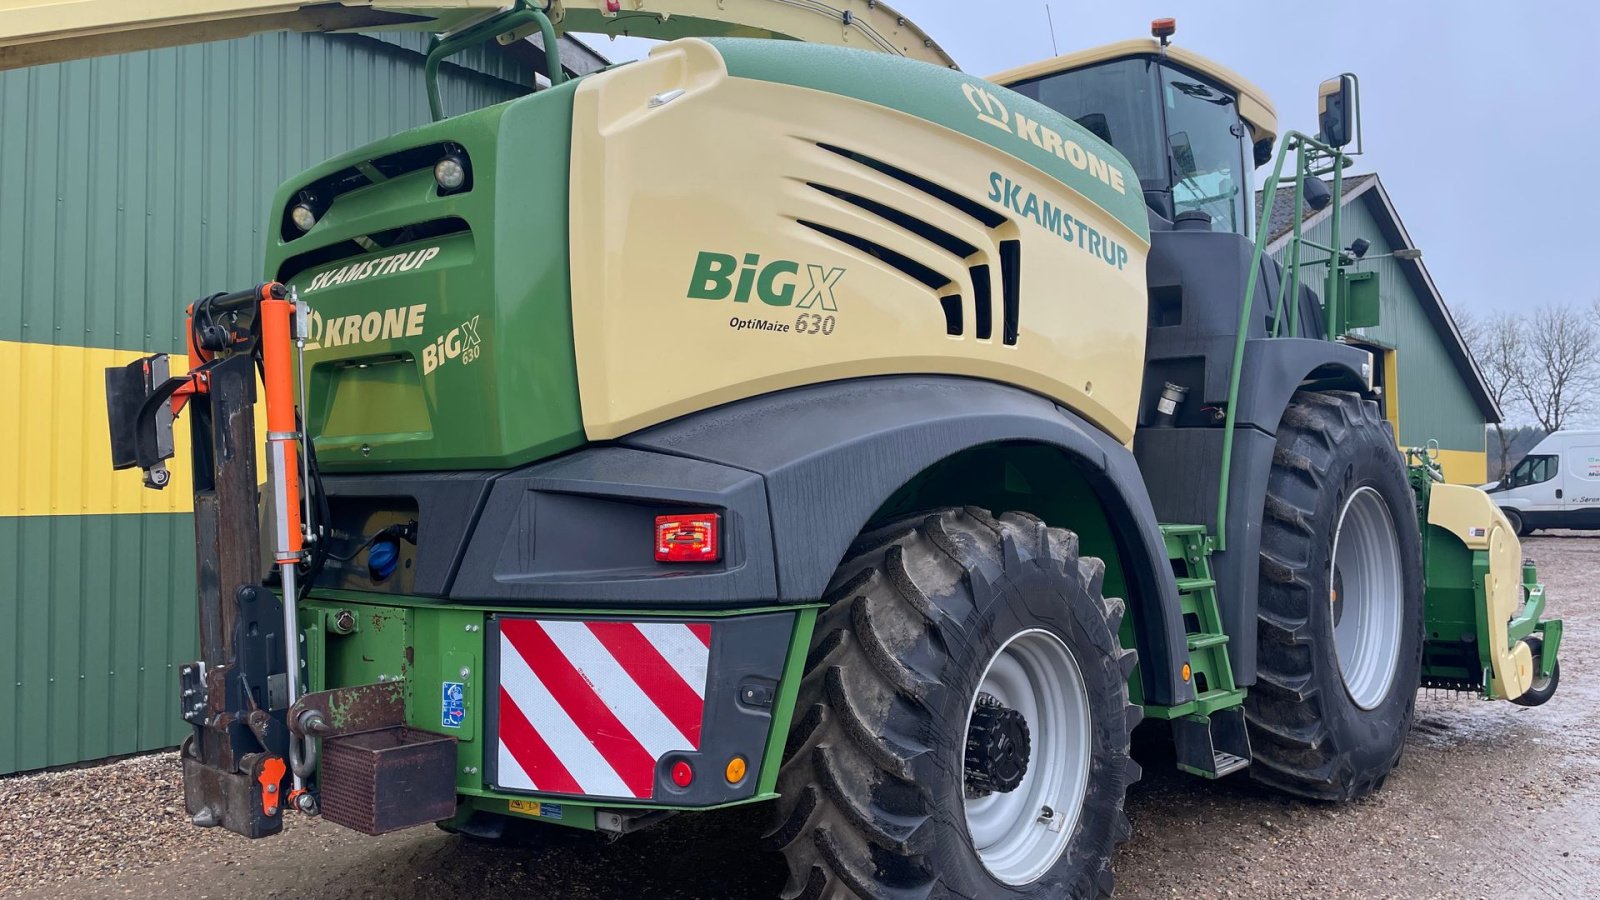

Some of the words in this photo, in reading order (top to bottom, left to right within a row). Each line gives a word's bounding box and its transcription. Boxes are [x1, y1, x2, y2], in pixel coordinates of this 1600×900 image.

[1015, 112, 1125, 195] KRONE
[988, 171, 1128, 270] SKAMSTRUP
[304, 247, 440, 293] SKAMSTRUP
[324, 304, 427, 348] KRONE
[729, 316, 790, 332] OptiMaize
[795, 313, 836, 335] 630
[462, 345, 480, 365] 630
